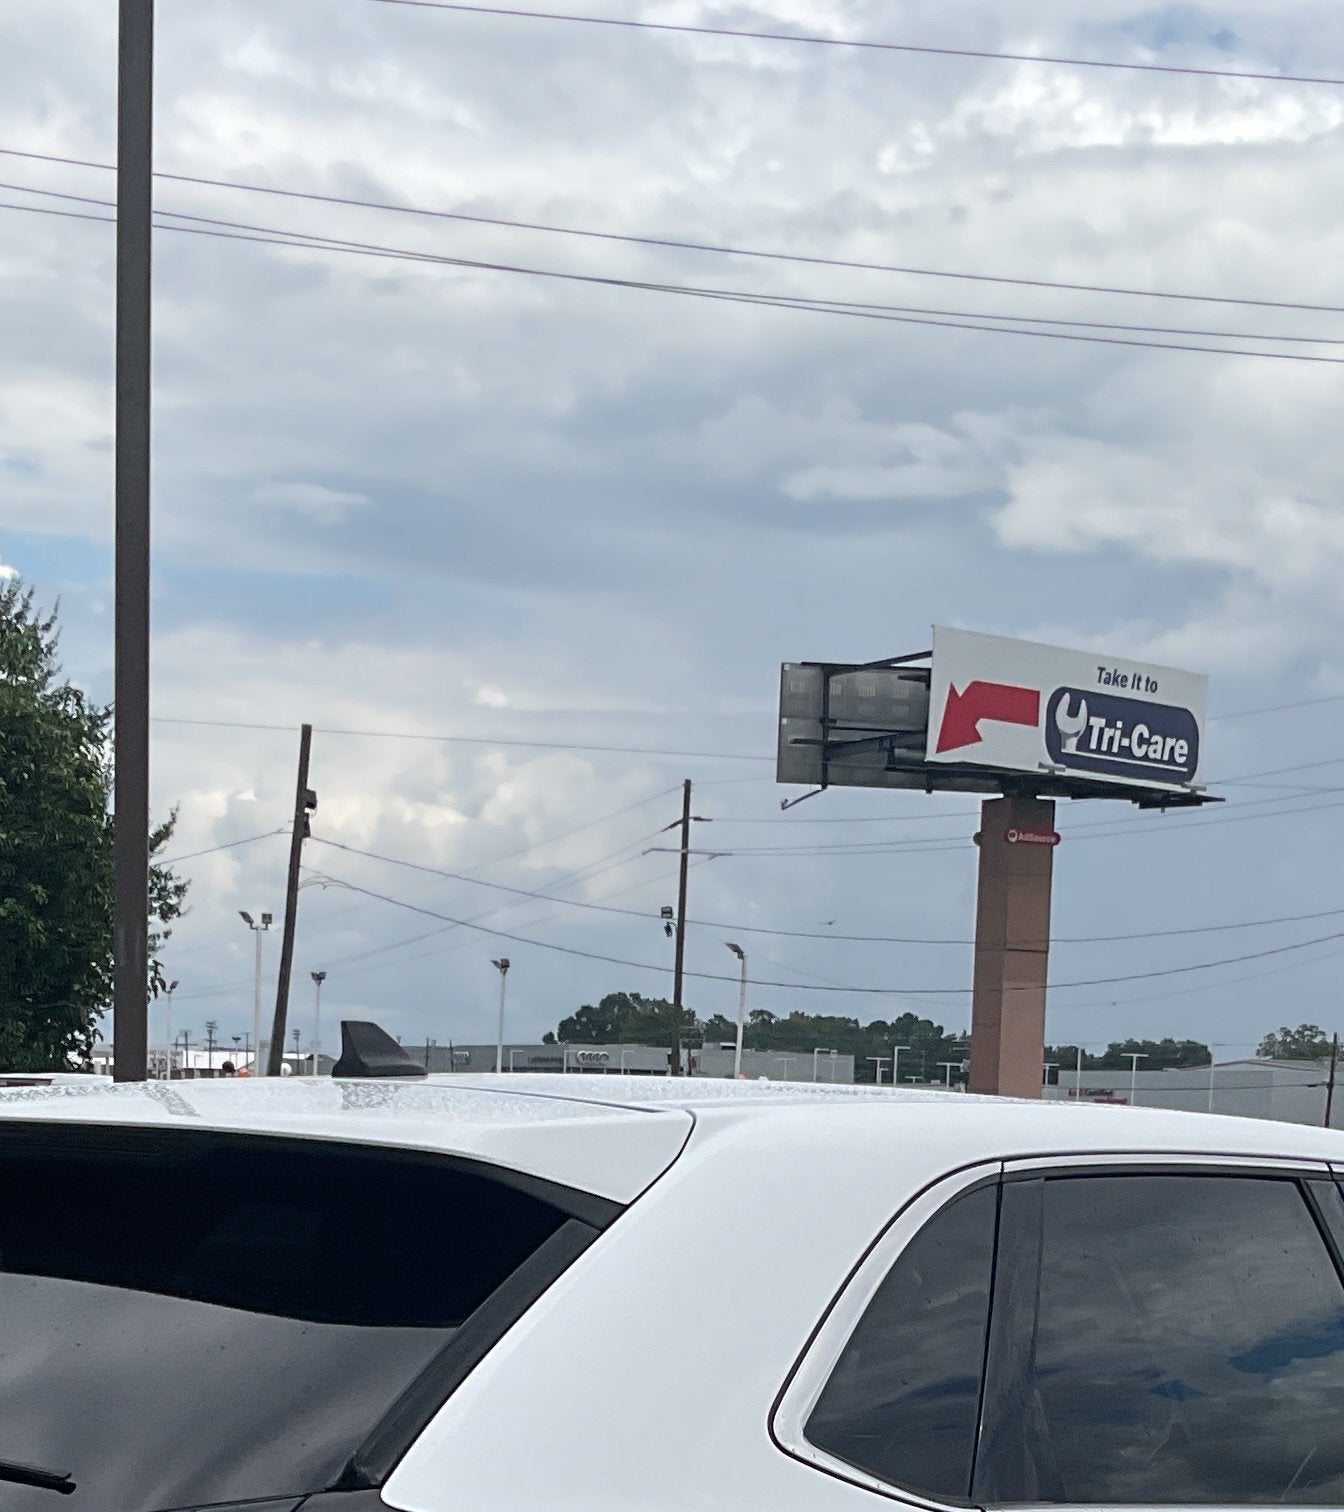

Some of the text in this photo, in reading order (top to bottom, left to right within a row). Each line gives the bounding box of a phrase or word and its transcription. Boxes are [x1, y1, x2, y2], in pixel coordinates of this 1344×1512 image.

[1096, 666, 1158, 694] Take It to
[1087, 716, 1189, 764] Tri-Care
